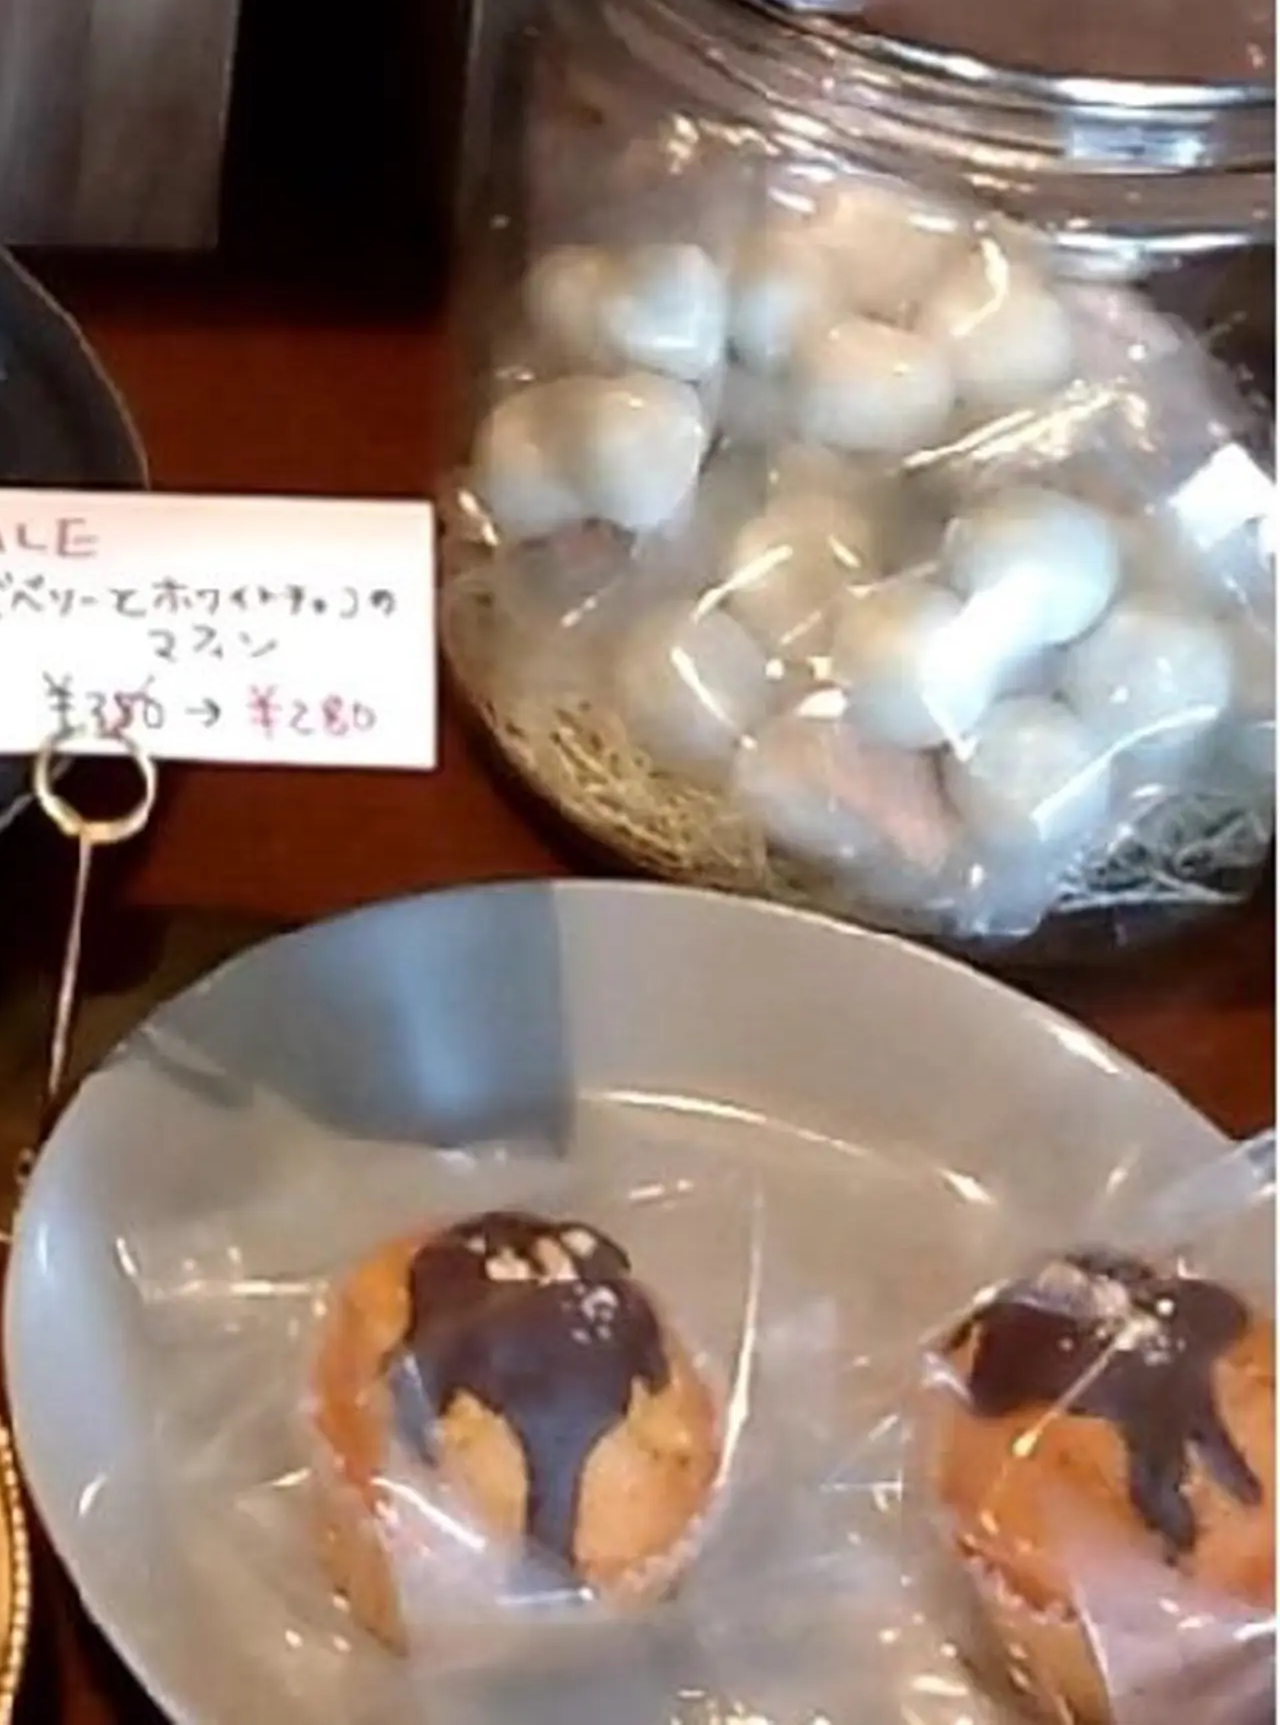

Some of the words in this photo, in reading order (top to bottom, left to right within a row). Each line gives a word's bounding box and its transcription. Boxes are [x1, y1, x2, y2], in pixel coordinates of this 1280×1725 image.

[148, 624, 278, 662] マフィン
[248, 685, 377, 738] ¥280
